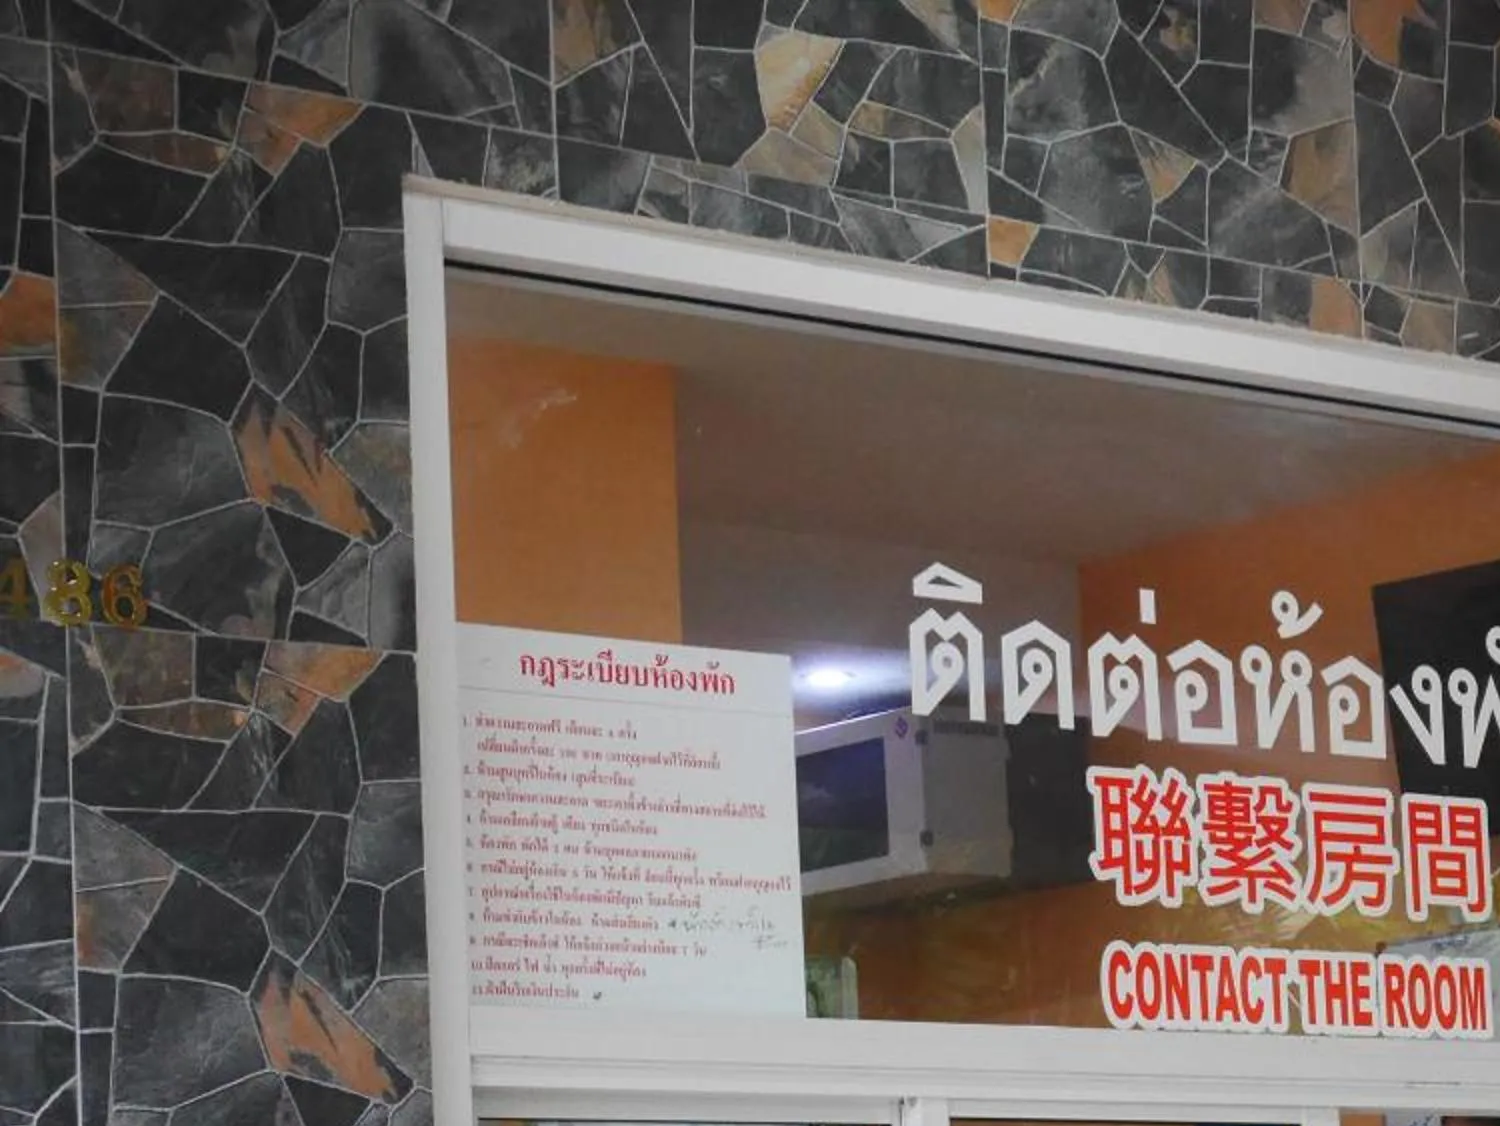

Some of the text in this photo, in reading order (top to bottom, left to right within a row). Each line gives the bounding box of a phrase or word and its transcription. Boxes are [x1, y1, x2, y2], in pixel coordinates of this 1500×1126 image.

[1092, 771, 1490, 916] 聯繫房間
[1108, 949, 1488, 1033] CONTACT THE ROOM
